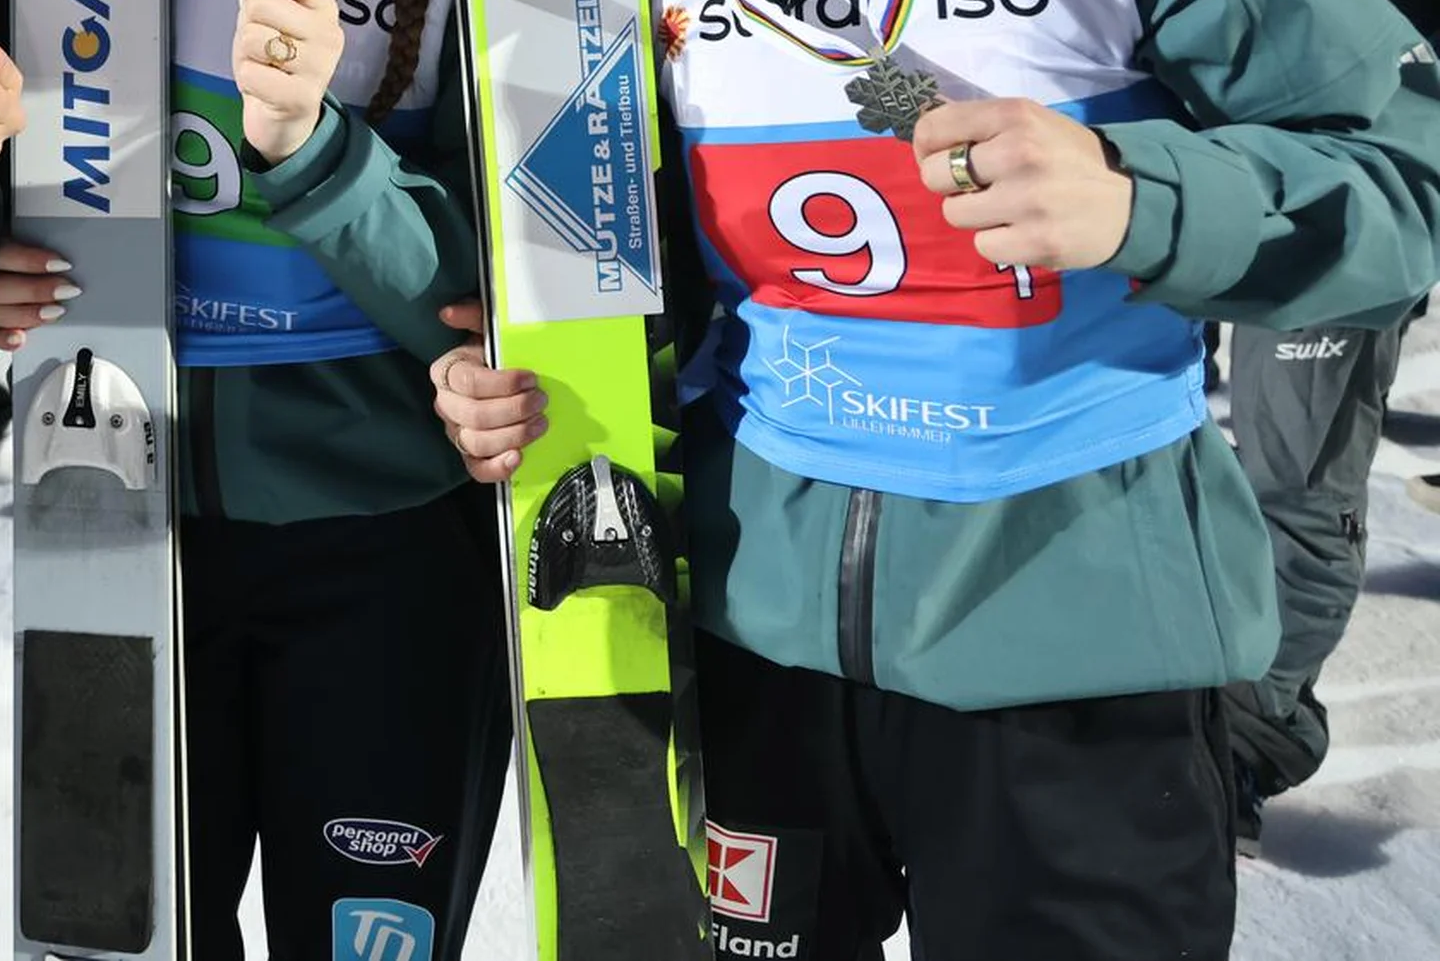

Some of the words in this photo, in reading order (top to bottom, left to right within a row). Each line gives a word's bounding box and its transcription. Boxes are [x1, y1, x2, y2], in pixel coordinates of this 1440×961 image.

[617, 75, 634, 137] Tiefbau
[172, 110, 242, 216] 9
[593, 139, 610, 160] &
[623, 141, 637, 174] und
[623, 179, 643, 249] Straßen-
[768, 170, 907, 297] 9
[841, 390, 996, 430] SKIFEST
[332, 824, 418, 847] personal
[349, 836, 397, 857] shop
